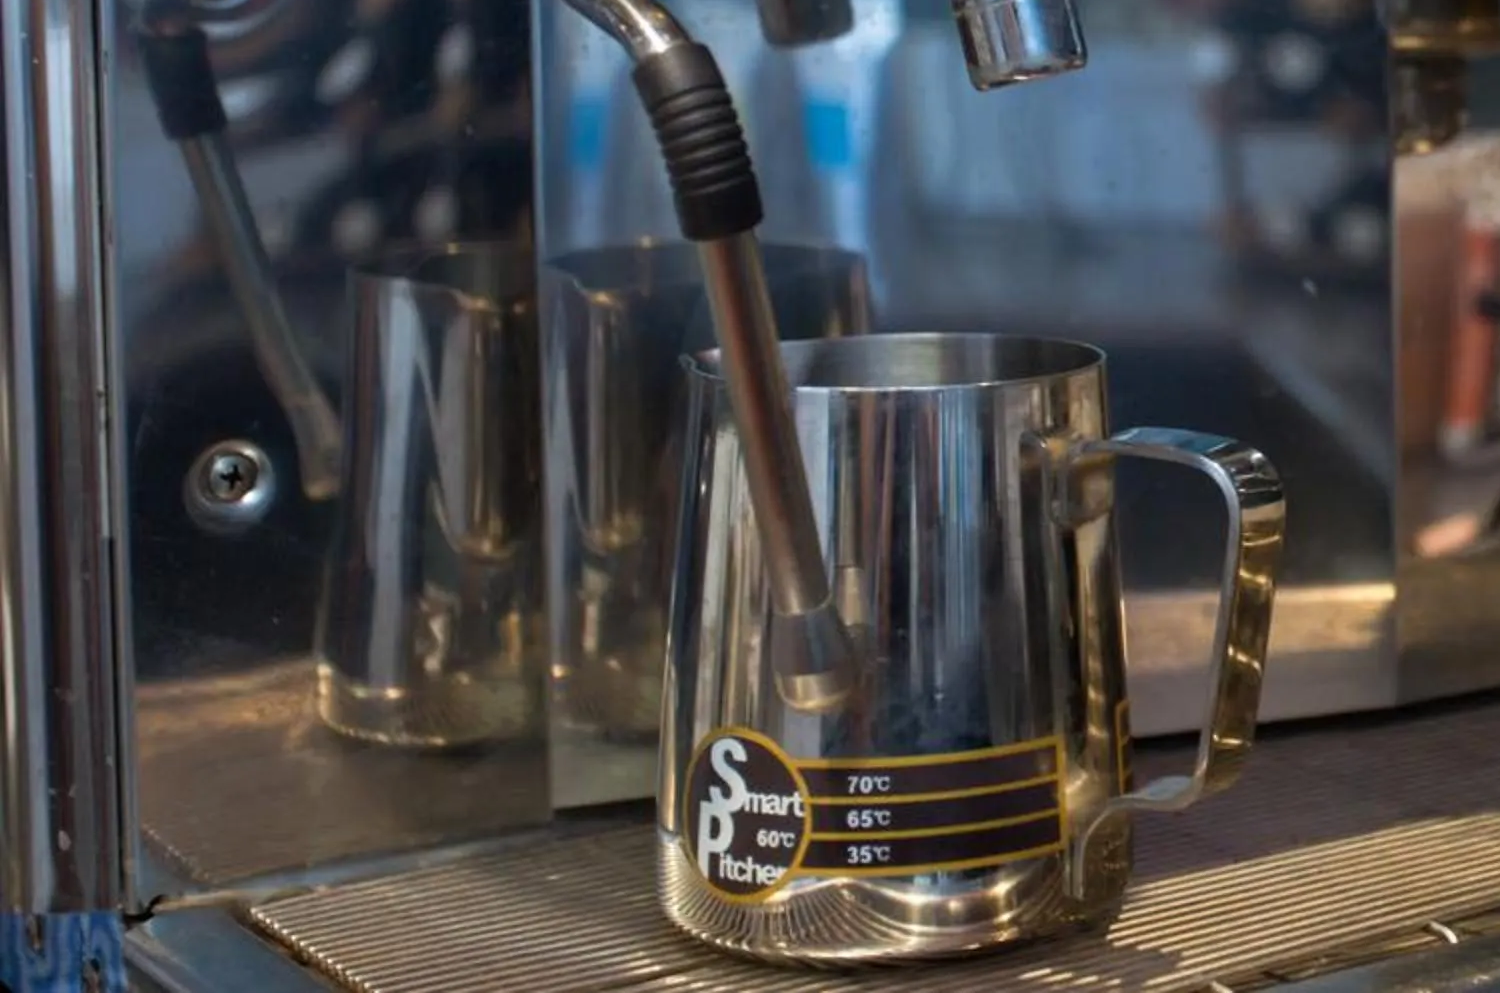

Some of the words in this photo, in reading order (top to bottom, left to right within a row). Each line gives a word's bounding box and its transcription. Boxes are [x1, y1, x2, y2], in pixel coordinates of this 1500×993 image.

[709, 737, 806, 818] Smart
[847, 776, 891, 794] 70°C
[847, 810, 891, 828] 65°C
[847, 846, 891, 864] 35°C
